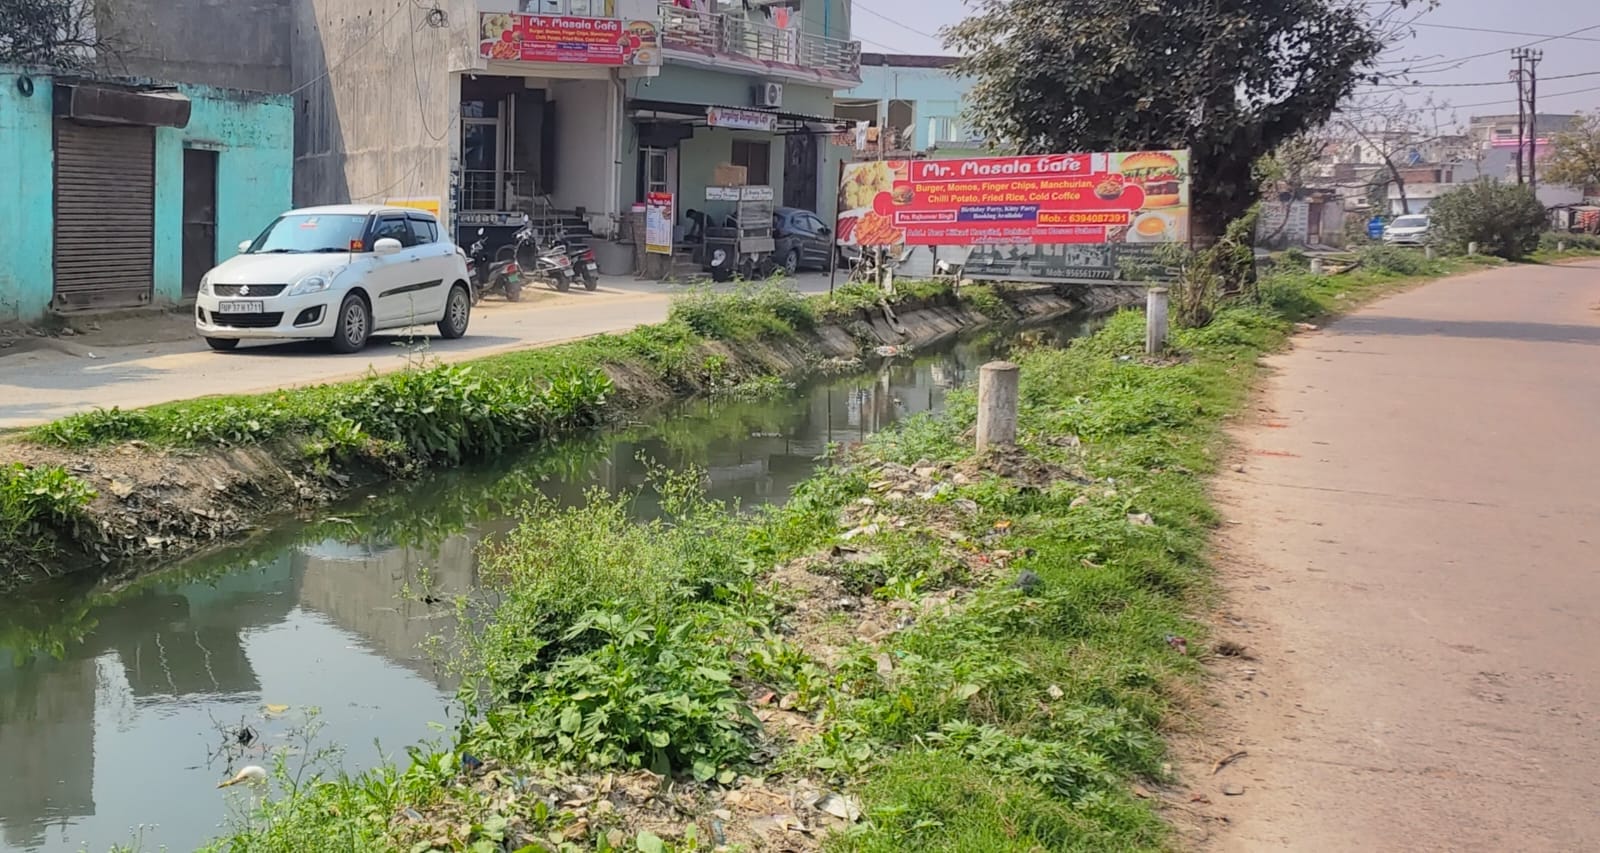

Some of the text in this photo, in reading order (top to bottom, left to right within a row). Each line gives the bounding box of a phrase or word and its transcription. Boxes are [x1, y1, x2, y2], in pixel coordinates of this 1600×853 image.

[529, 17, 618, 31] Mr. Masala Cafe
[922, 158, 1081, 177] Mr. Masala Cafe
[916, 179, 1095, 192] Burger, Momos, Finger Chips, Manchurian,
[928, 191, 1081, 203] Chilli Potato, Fried Rice, Cold Coffee
[1039, 212, 1126, 222] Mob.: 6394087391
